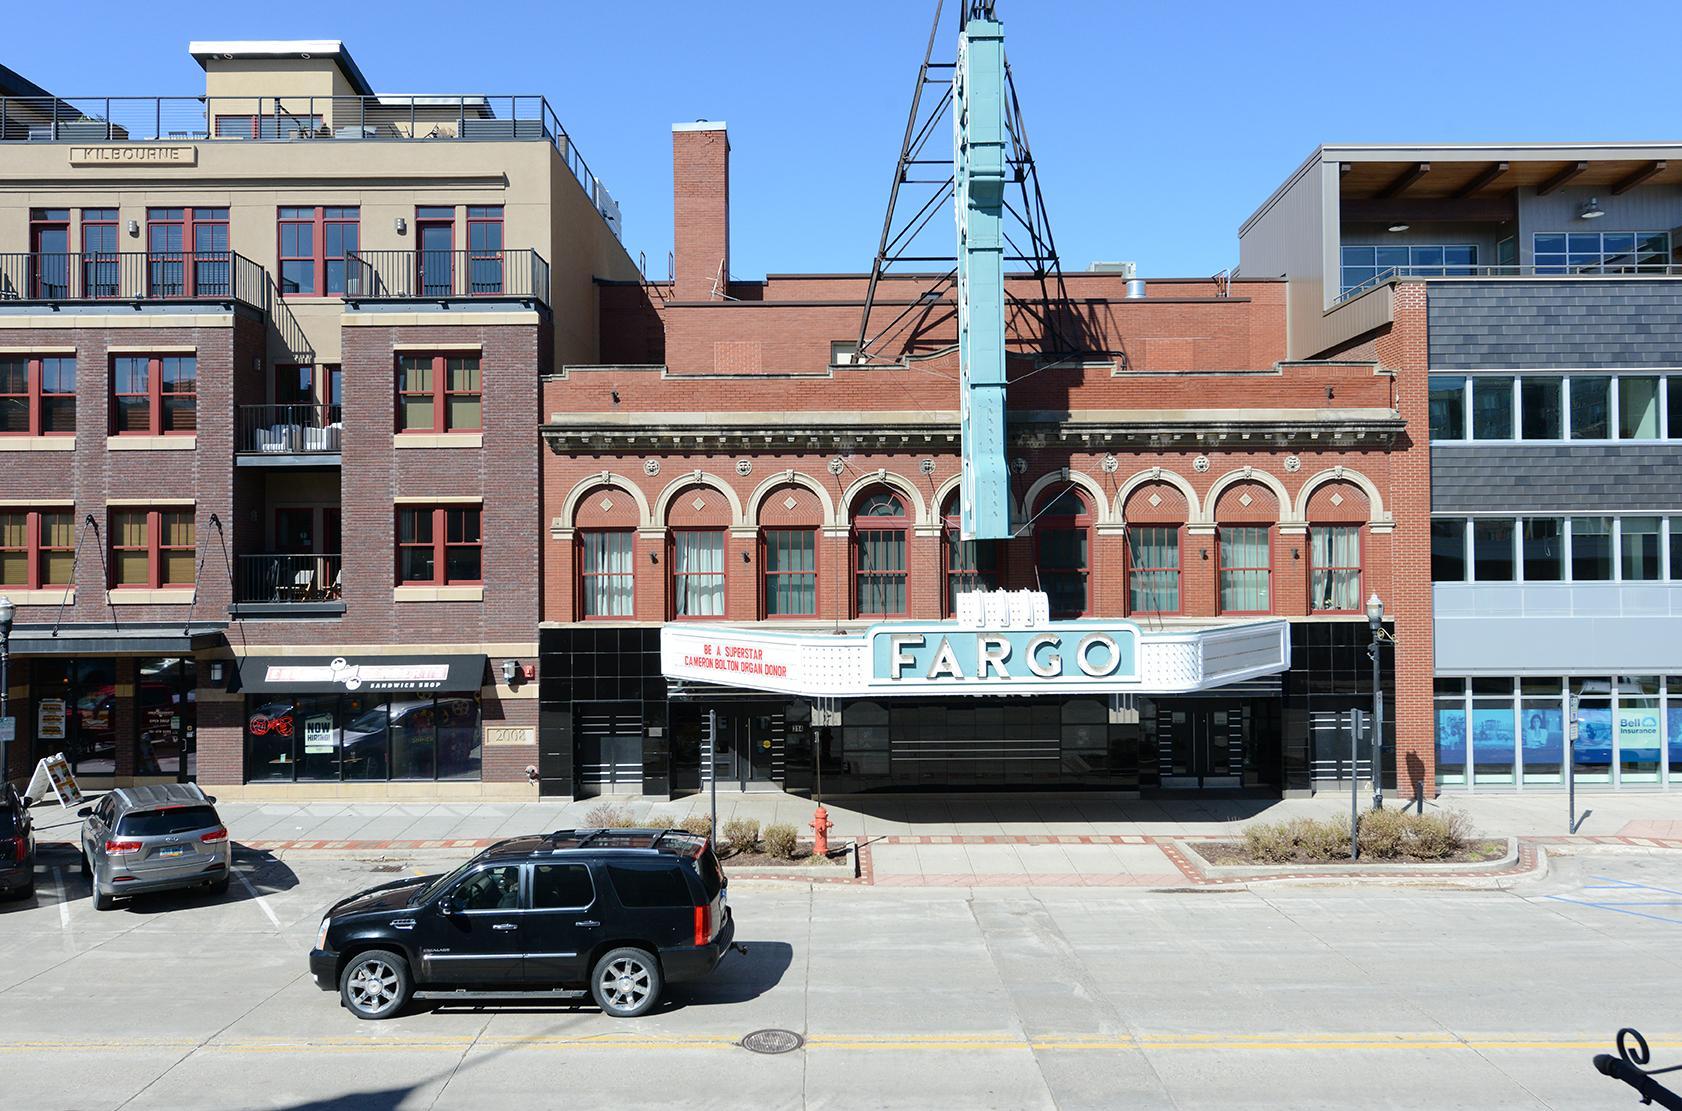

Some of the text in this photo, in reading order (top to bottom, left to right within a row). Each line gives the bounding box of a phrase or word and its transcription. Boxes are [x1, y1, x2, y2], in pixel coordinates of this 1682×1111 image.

[83, 148, 180, 160] KILBOURNE
[703, 644, 763, 660] BE A SUPERSTAR
[890, 632, 1122, 680] FARGO
[684, 655, 787, 677] CAMERON BOLTON ORGAN DONOR
[307, 722, 331, 733] NOW
[1620, 718, 1641, 727] Bell
[495, 729, 527, 742] 2008
